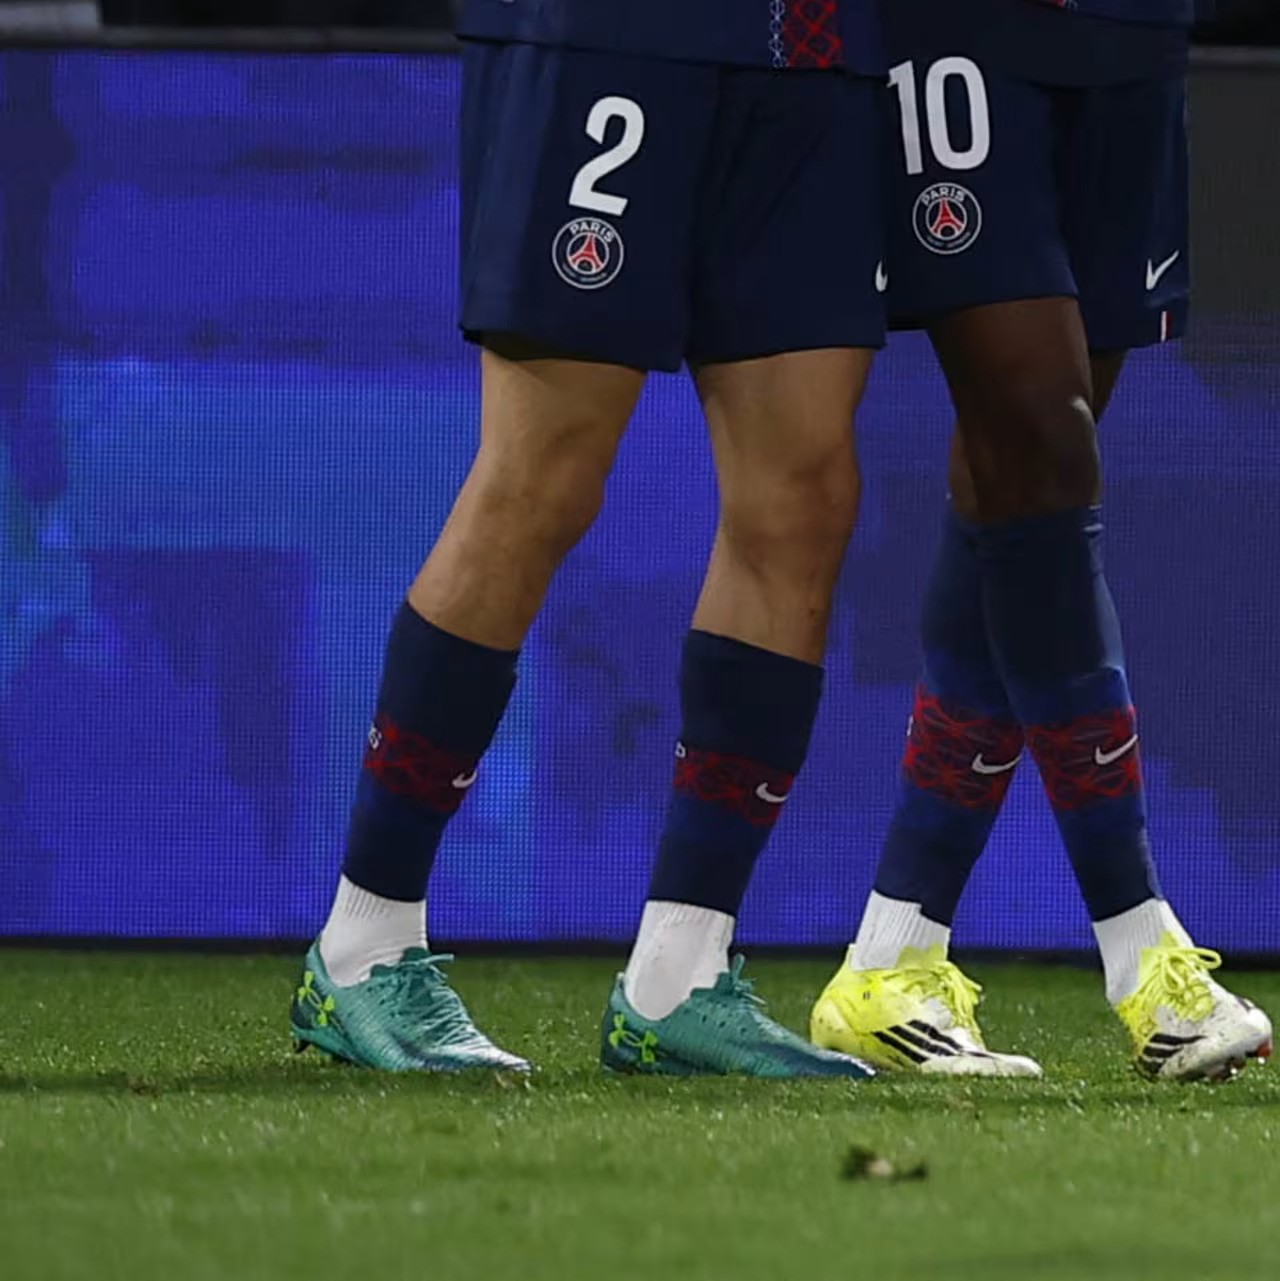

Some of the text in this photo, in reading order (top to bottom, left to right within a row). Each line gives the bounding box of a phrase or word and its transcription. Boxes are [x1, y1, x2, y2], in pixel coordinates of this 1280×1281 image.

[886, 56, 990, 175] 10
[569, 96, 644, 216] 2
[921, 187, 965, 206] PARIS
[569, 222, 615, 242] PARIS
